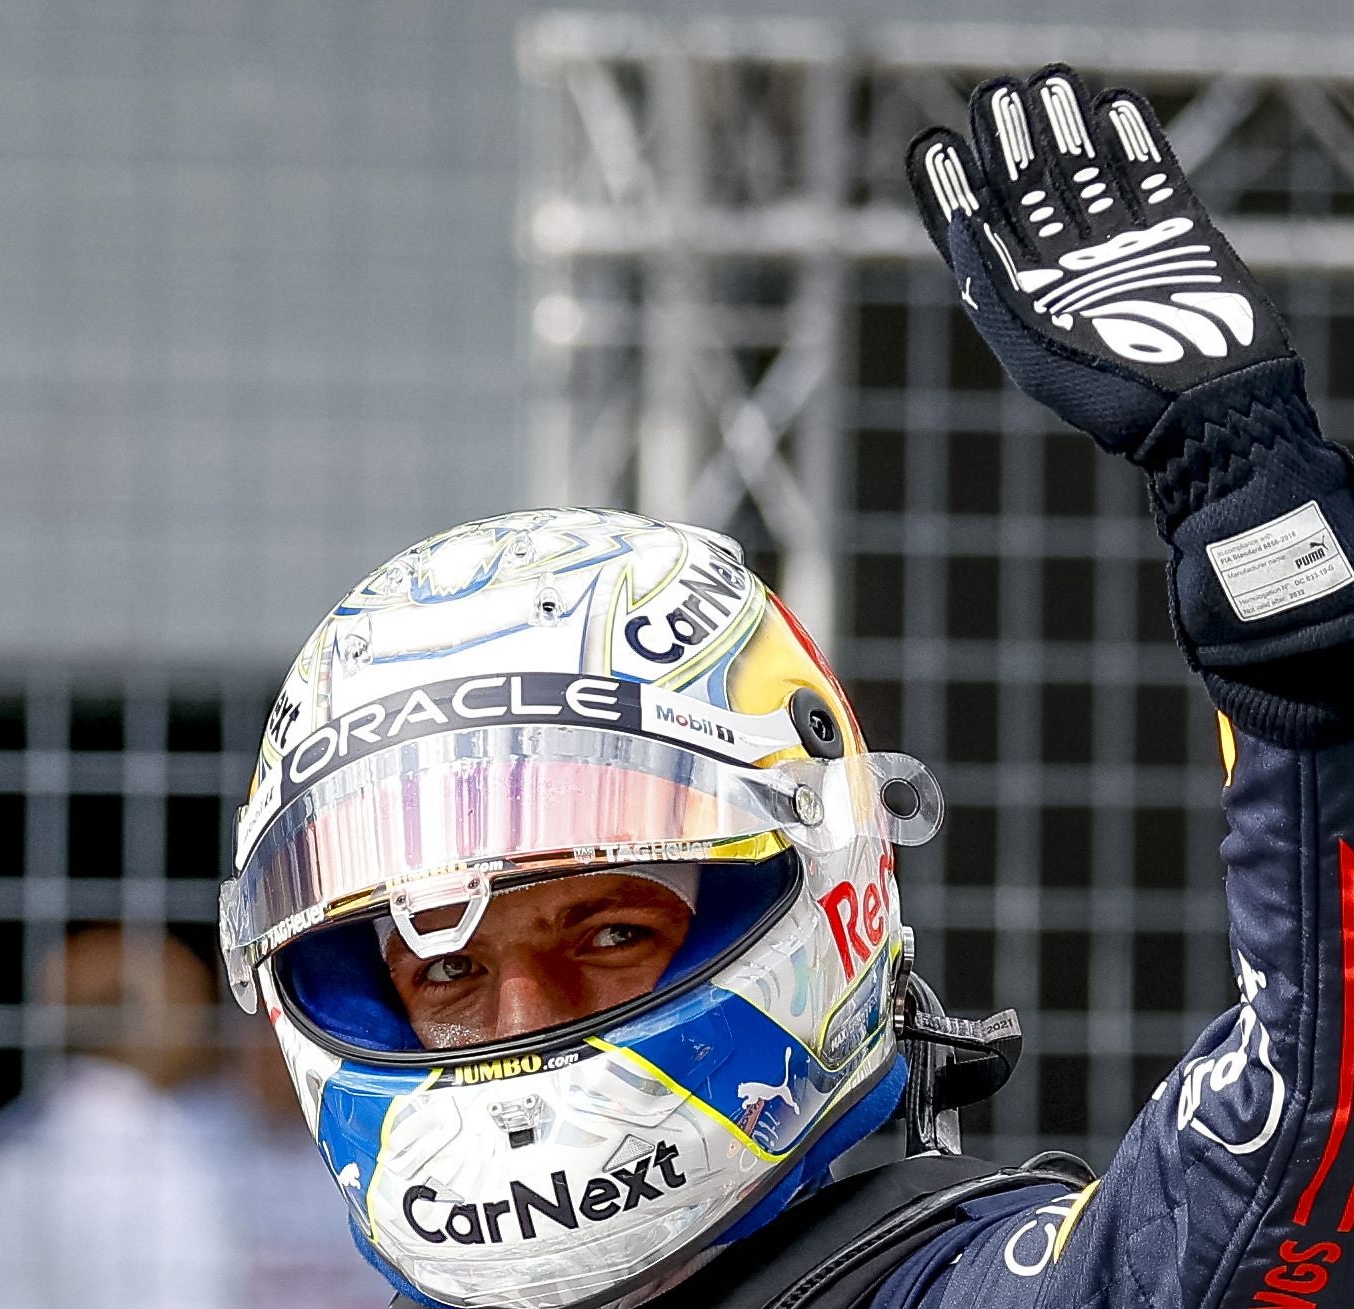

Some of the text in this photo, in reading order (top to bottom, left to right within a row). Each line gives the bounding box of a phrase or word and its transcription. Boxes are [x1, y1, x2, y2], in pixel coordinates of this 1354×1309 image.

[1294, 546, 1326, 570] PUMA
[290, 676, 622, 783] ORACLE
[655, 704, 714, 737] Mobil
[986, 1018, 1014, 1034] 2021
[403, 1140, 687, 1244] CarNext
